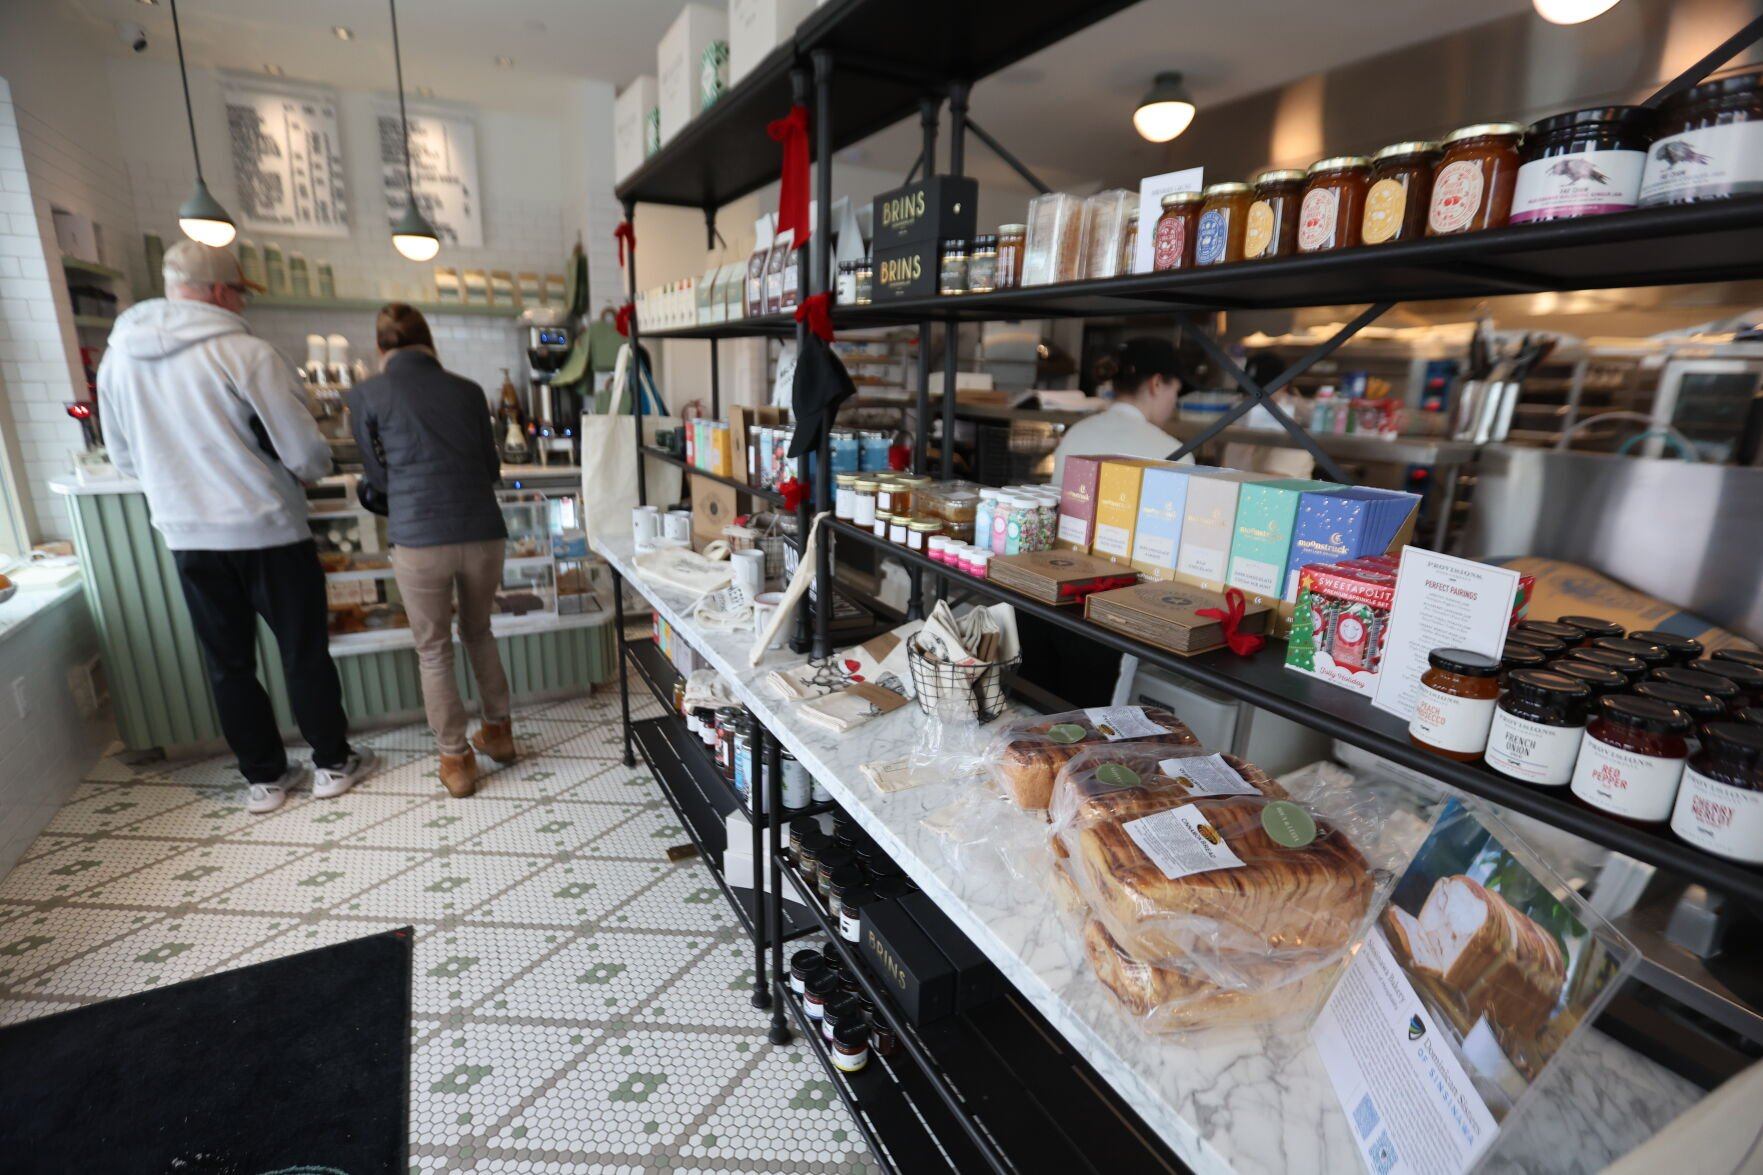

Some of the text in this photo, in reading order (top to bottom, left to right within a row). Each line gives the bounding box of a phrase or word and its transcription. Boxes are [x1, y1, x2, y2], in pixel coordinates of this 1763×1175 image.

[882, 190, 925, 226] BRINS
[880, 254, 921, 285] BRINS
[1296, 539, 1350, 555] moonstruck
[1323, 588, 1348, 598] PREMIUM
[1349, 594, 1376, 605] SPRINKLE
[1425, 579, 1479, 601] PERFECT PAIRINGS
[1420, 701, 1441, 715] PEACH
[1505, 731, 1537, 750] FRENCH
[1506, 742, 1531, 757] ONION
[1592, 769, 1629, 790] PEPPER
[1602, 764, 1620, 778] RED
[868, 930, 906, 990] BRINS
[1417, 1047, 1428, 1063] OF
[1424, 1037, 1481, 1136] Dominican Sisters
